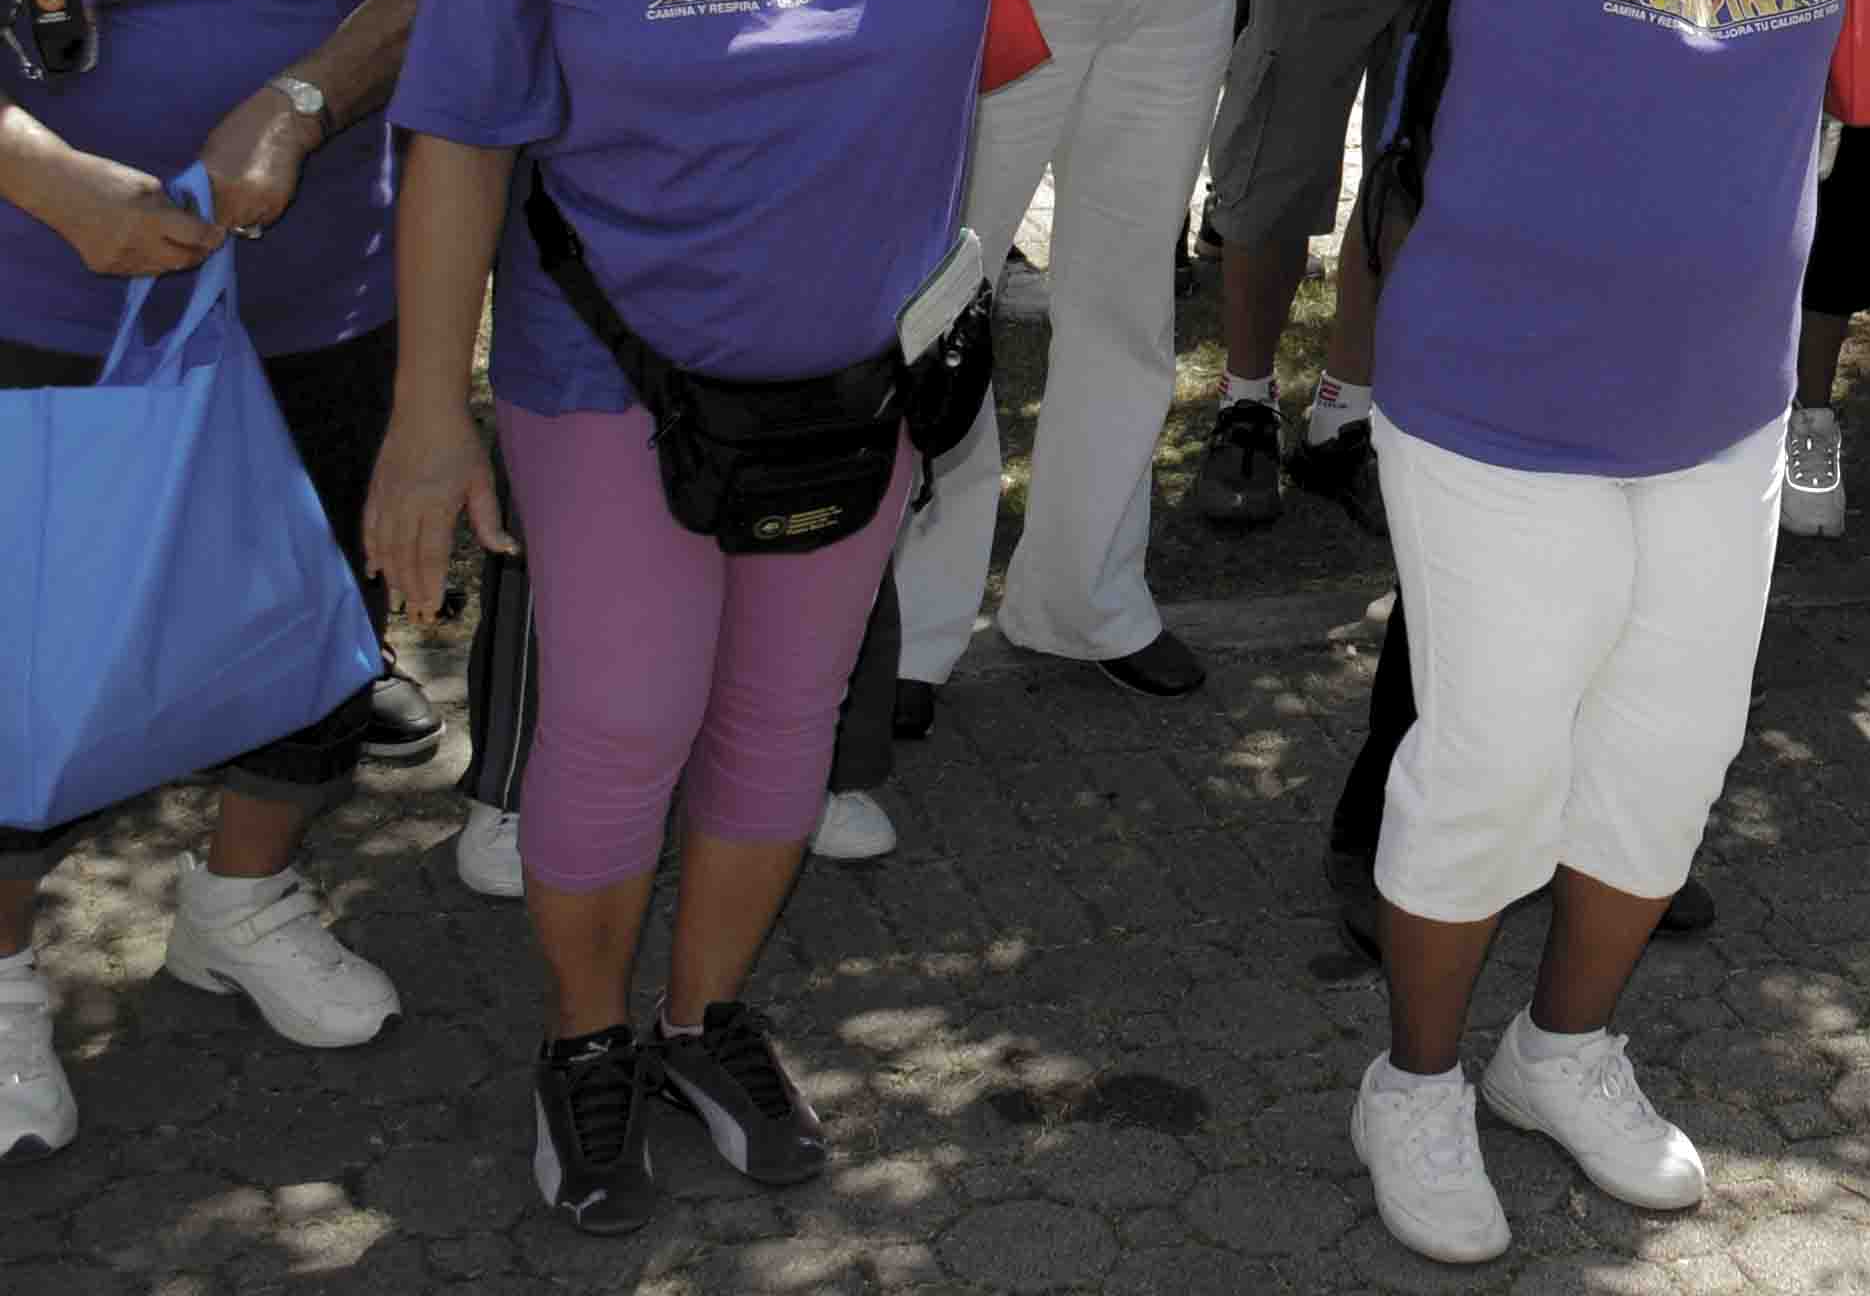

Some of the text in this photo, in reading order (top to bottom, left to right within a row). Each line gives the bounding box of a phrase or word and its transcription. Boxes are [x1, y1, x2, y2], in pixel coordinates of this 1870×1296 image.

[645, 5, 696, 20] CAMINA
[698, 5, 706, 16] Y
[708, 1, 761, 15] RESPIRA
[1602, 1, 1646, 22] CAMINA
[1648, 11, 1657, 23] Y
[1756, 20, 1769, 33] TU
[1770, 11, 1812, 30] CALIDAD
[1813, 8, 1825, 21] DE
